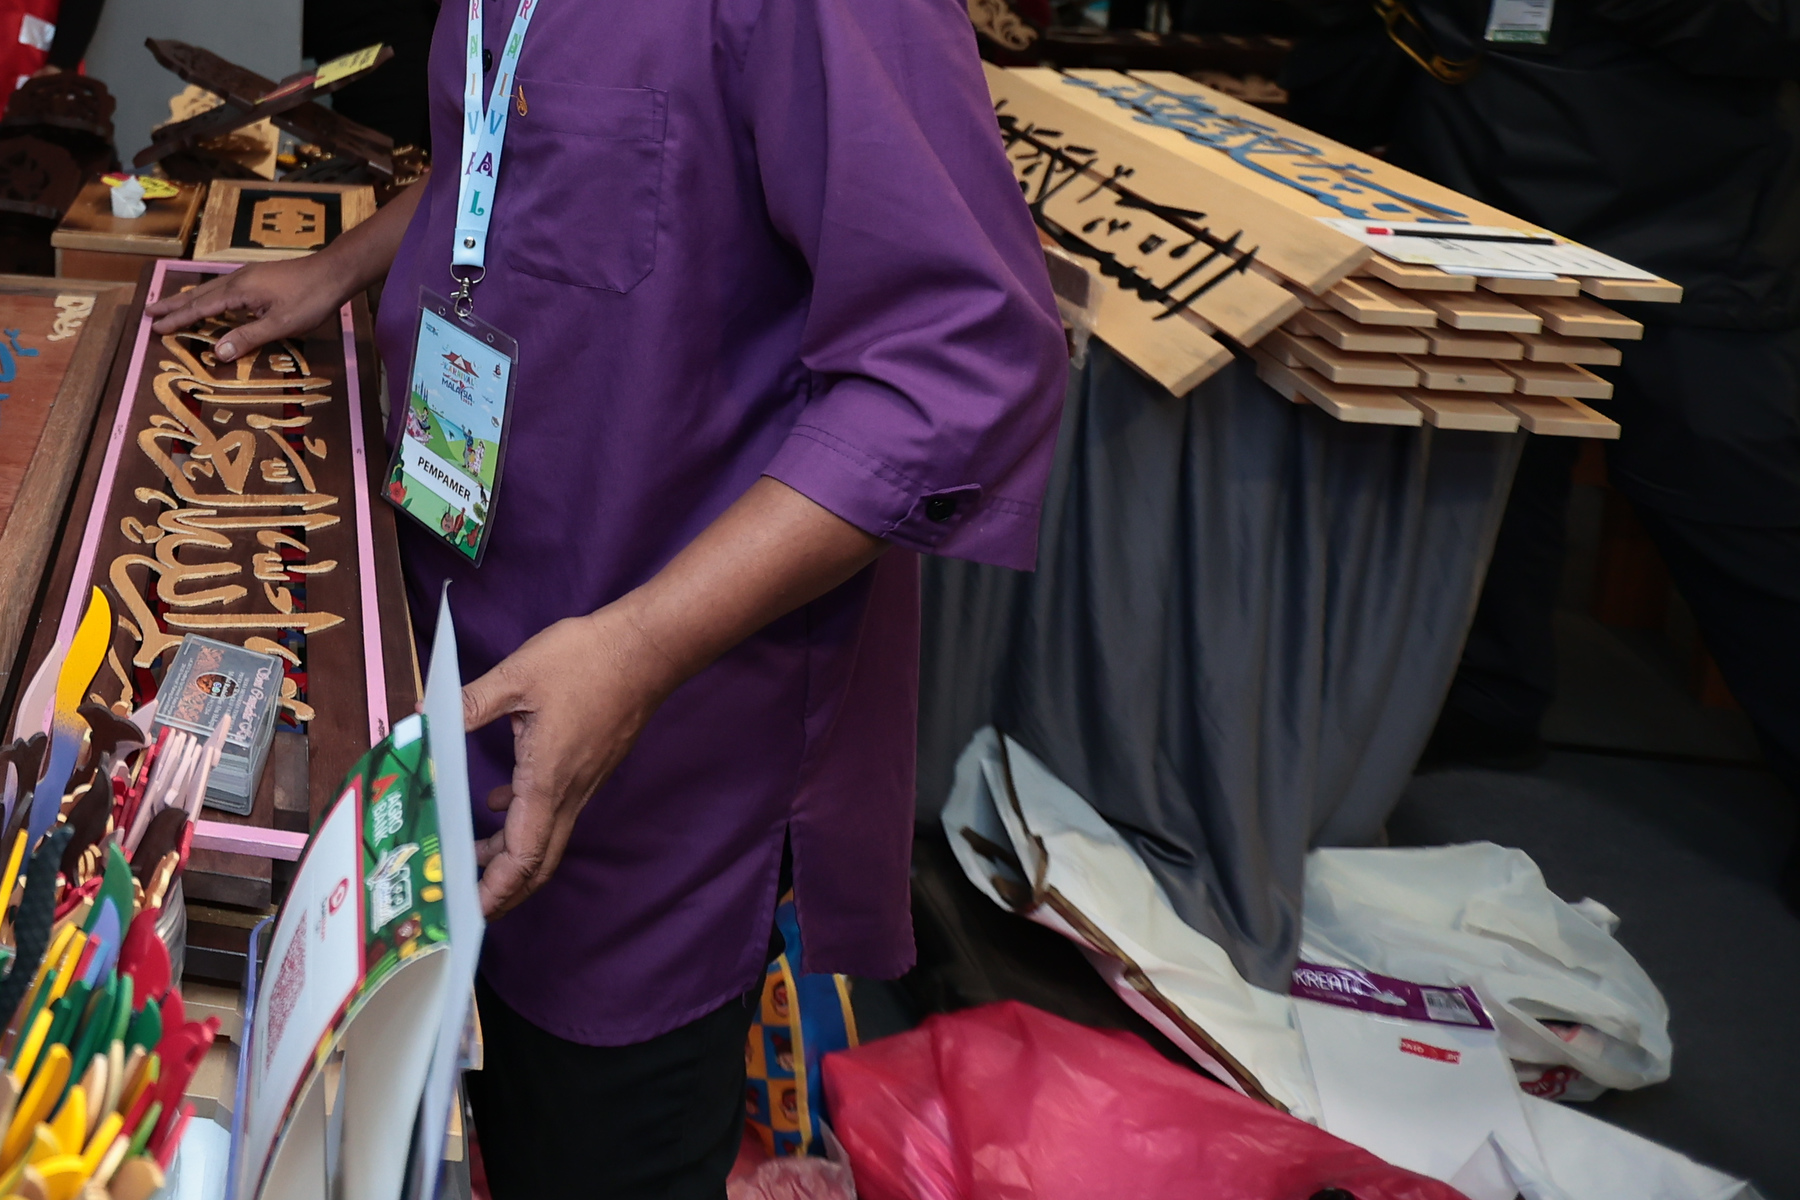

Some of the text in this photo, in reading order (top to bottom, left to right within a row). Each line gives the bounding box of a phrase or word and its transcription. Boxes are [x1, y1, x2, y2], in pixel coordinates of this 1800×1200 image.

[441, 377, 473, 402] MALAYSIA
[417, 455, 472, 502] PEMPAMER
[372, 802, 390, 849] BANK
[386, 789, 406, 836] AGRO
